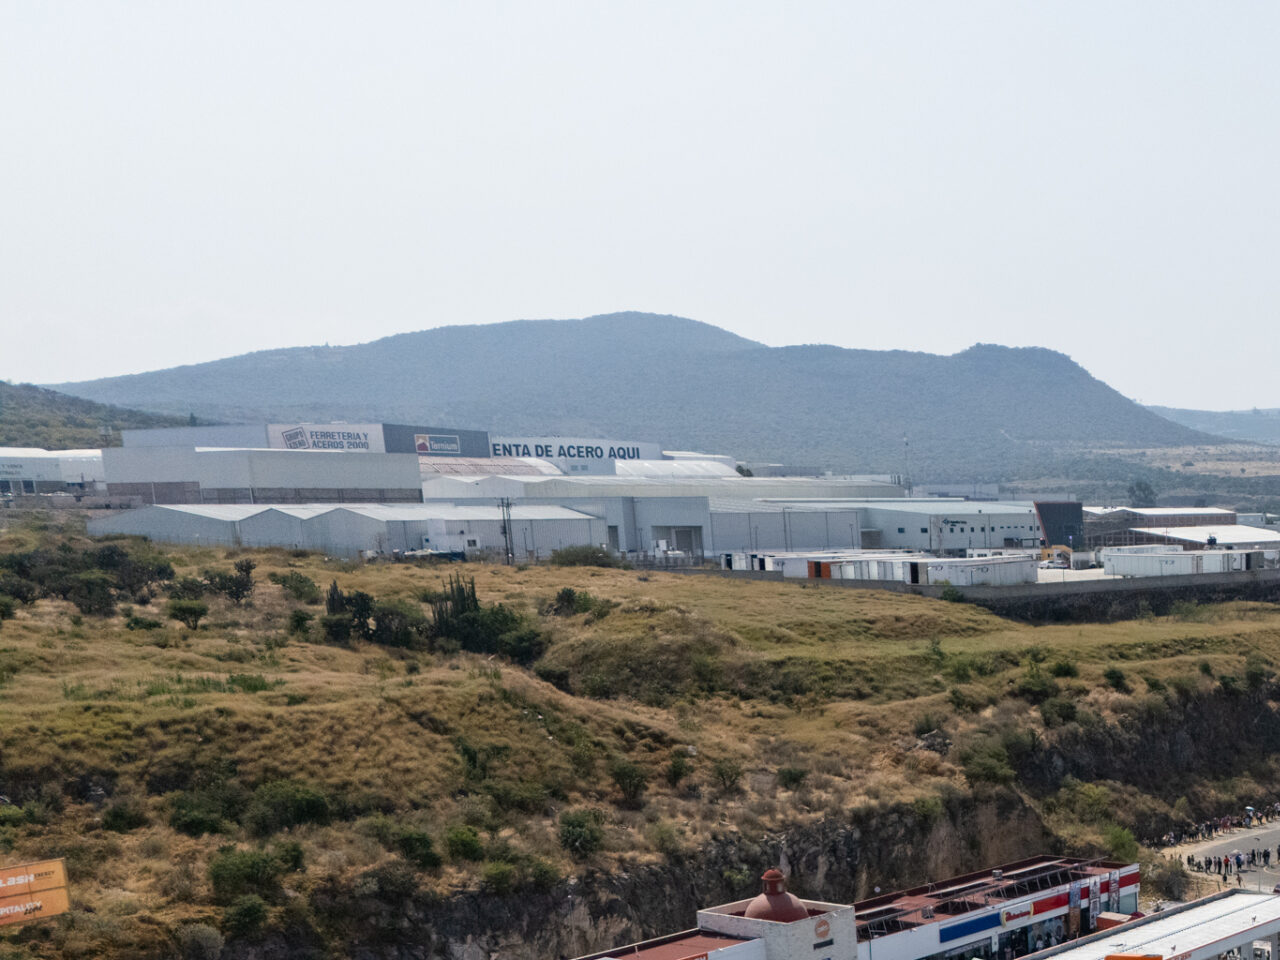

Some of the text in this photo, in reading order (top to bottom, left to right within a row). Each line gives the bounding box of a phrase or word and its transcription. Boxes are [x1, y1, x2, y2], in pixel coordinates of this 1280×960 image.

[310, 430, 369, 441] FERRETERIA Y
[311, 439, 370, 451] ACEROS 2000
[491, 443, 641, 460] ENTA DE ACERO AQUI
